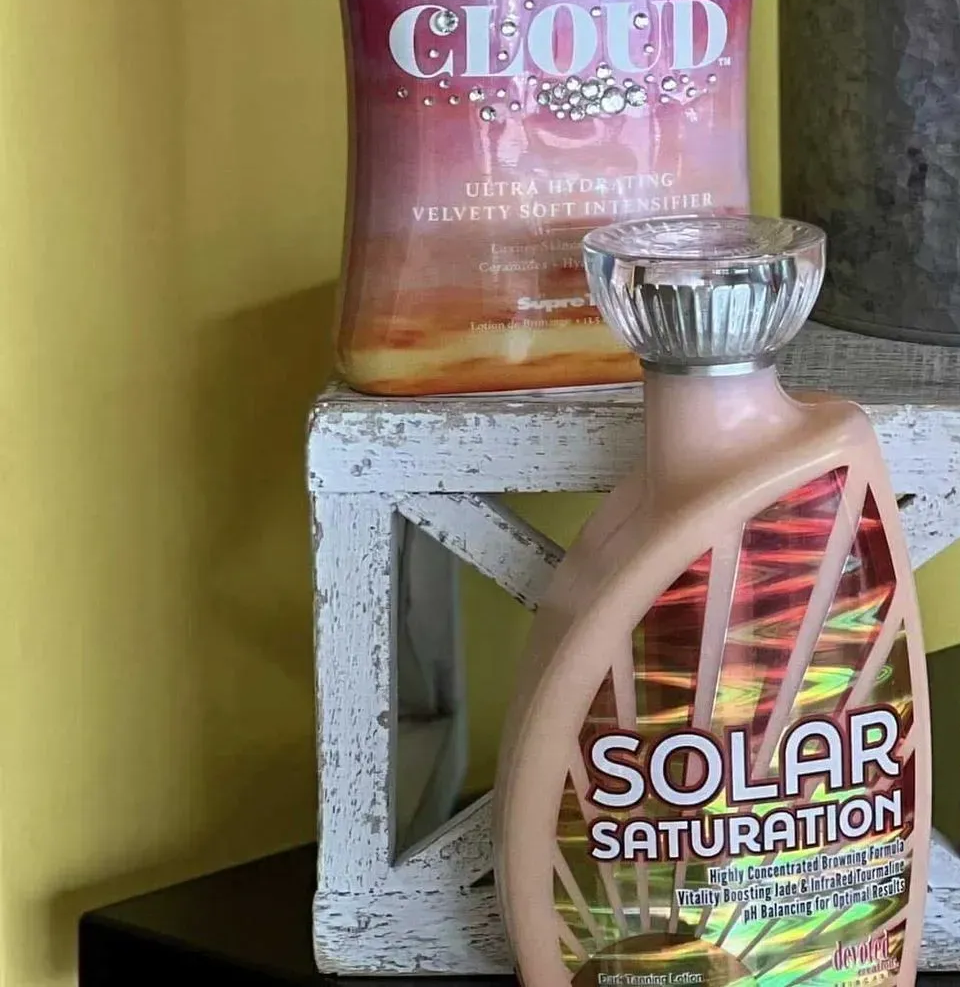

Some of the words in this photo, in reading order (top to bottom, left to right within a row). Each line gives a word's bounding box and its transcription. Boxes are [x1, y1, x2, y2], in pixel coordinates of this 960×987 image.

[466, 181, 538, 198] ULTRA
[550, 172, 674, 196] HYDRATING
[412, 205, 511, 222] VELVETY
[520, 202, 576, 219] SOFT
[585, 192, 714, 215] INTENSIFIER
[517, 297, 585, 312] Supre
[588, 708, 901, 809] SOLAR
[590, 789, 902, 861] SATURATION
[678, 888, 719, 906] Vitality
[724, 882, 771, 903] Boosting
[774, 880, 797, 897] Jade
[800, 879, 807, 893] &
[811, 871, 853, 891] InfraRed
[856, 860, 904, 883] Tourmaline
[710, 867, 743, 885] Highly
[748, 859, 819, 880] Concentrated
[822, 851, 867, 870] Browning
[870, 840, 904, 860] Formula
[744, 905, 757, 923] pH
[761, 898, 812, 919] Balancing
[815, 894, 829, 911] for
[833, 887, 870, 908] Optimal
[872, 879, 905, 897] Results
[832, 929, 889, 971] devoted
[669, 972, 703, 984] Lotion
